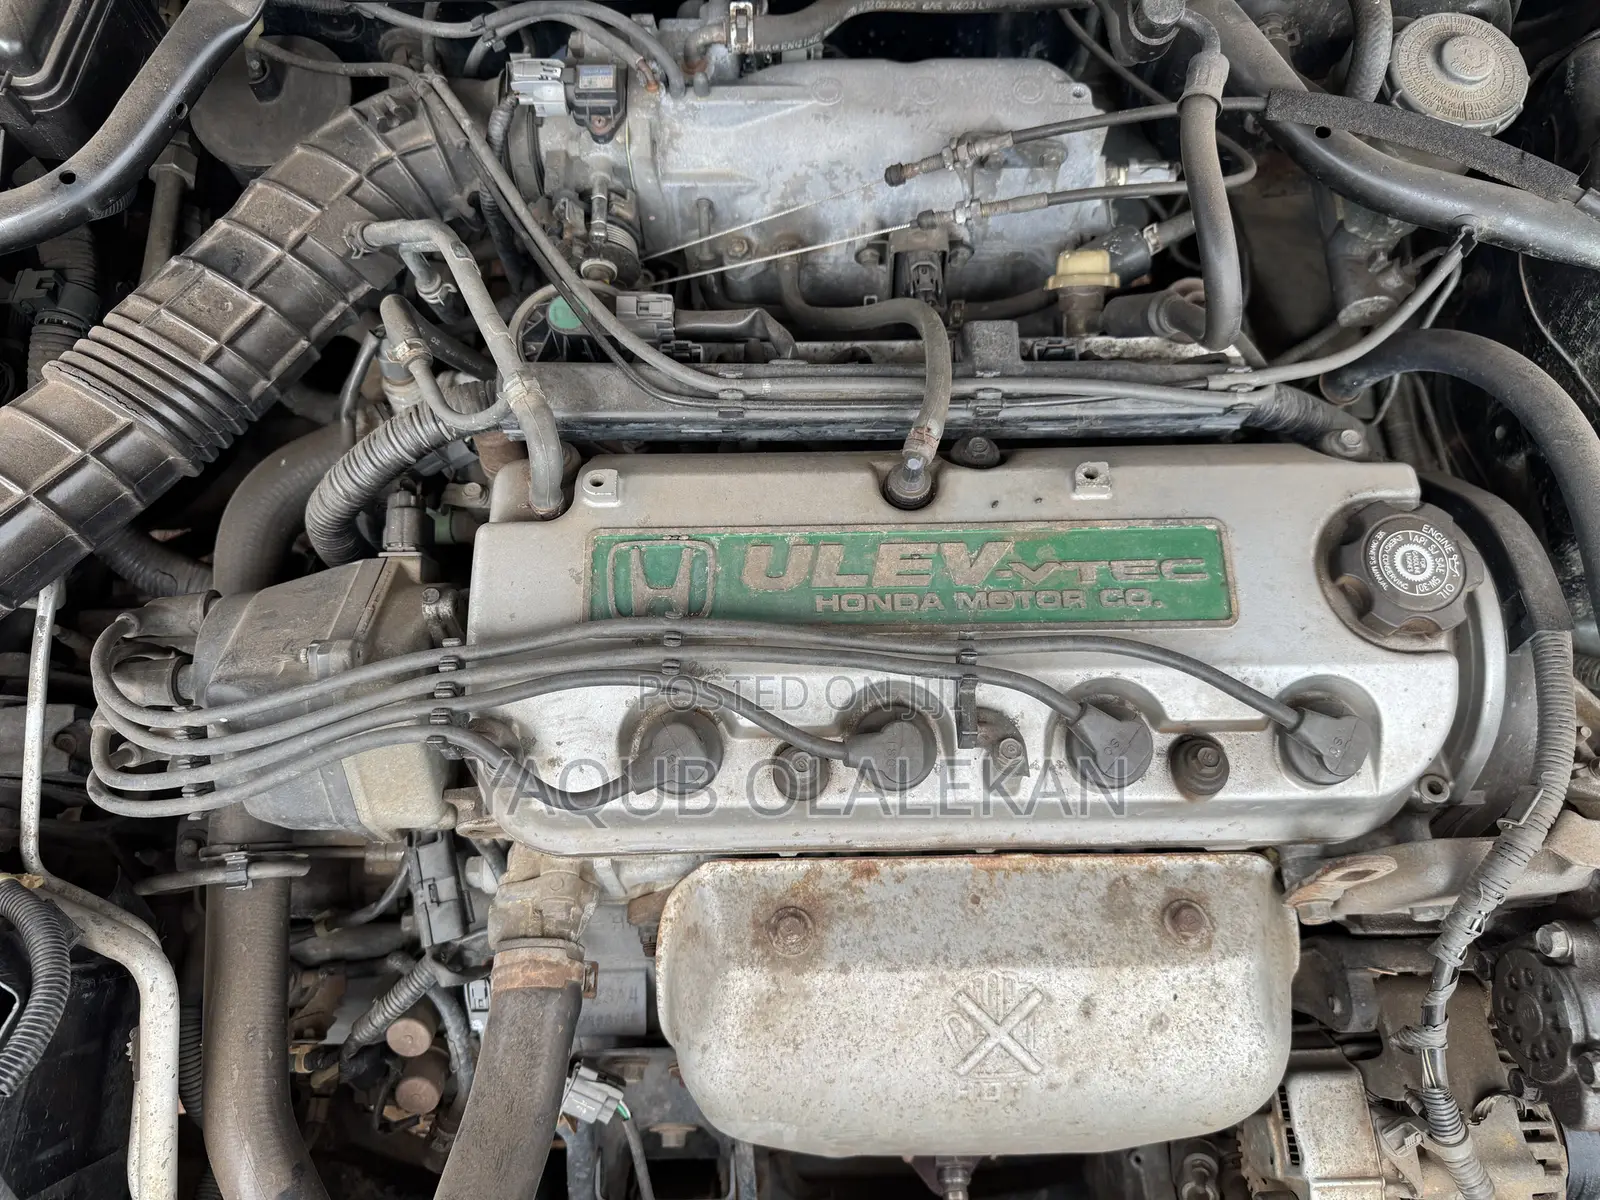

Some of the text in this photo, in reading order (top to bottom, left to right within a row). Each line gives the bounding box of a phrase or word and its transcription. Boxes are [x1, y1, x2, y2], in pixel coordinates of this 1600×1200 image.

[1375, 530, 1387, 541] SEE
[1412, 535, 1427, 546] API
[1427, 544, 1439, 556] SJ
[1434, 556, 1445, 575] SAE
[741, 541, 1014, 591] ULEV
[1371, 564, 1389, 592] MANUAL
[1381, 535, 1410, 591] ENERGY CONSERVING
[1421, 524, 1456, 600] ENGINE OIL
[815, 587, 1165, 613] HONDA MOTOR CO.
